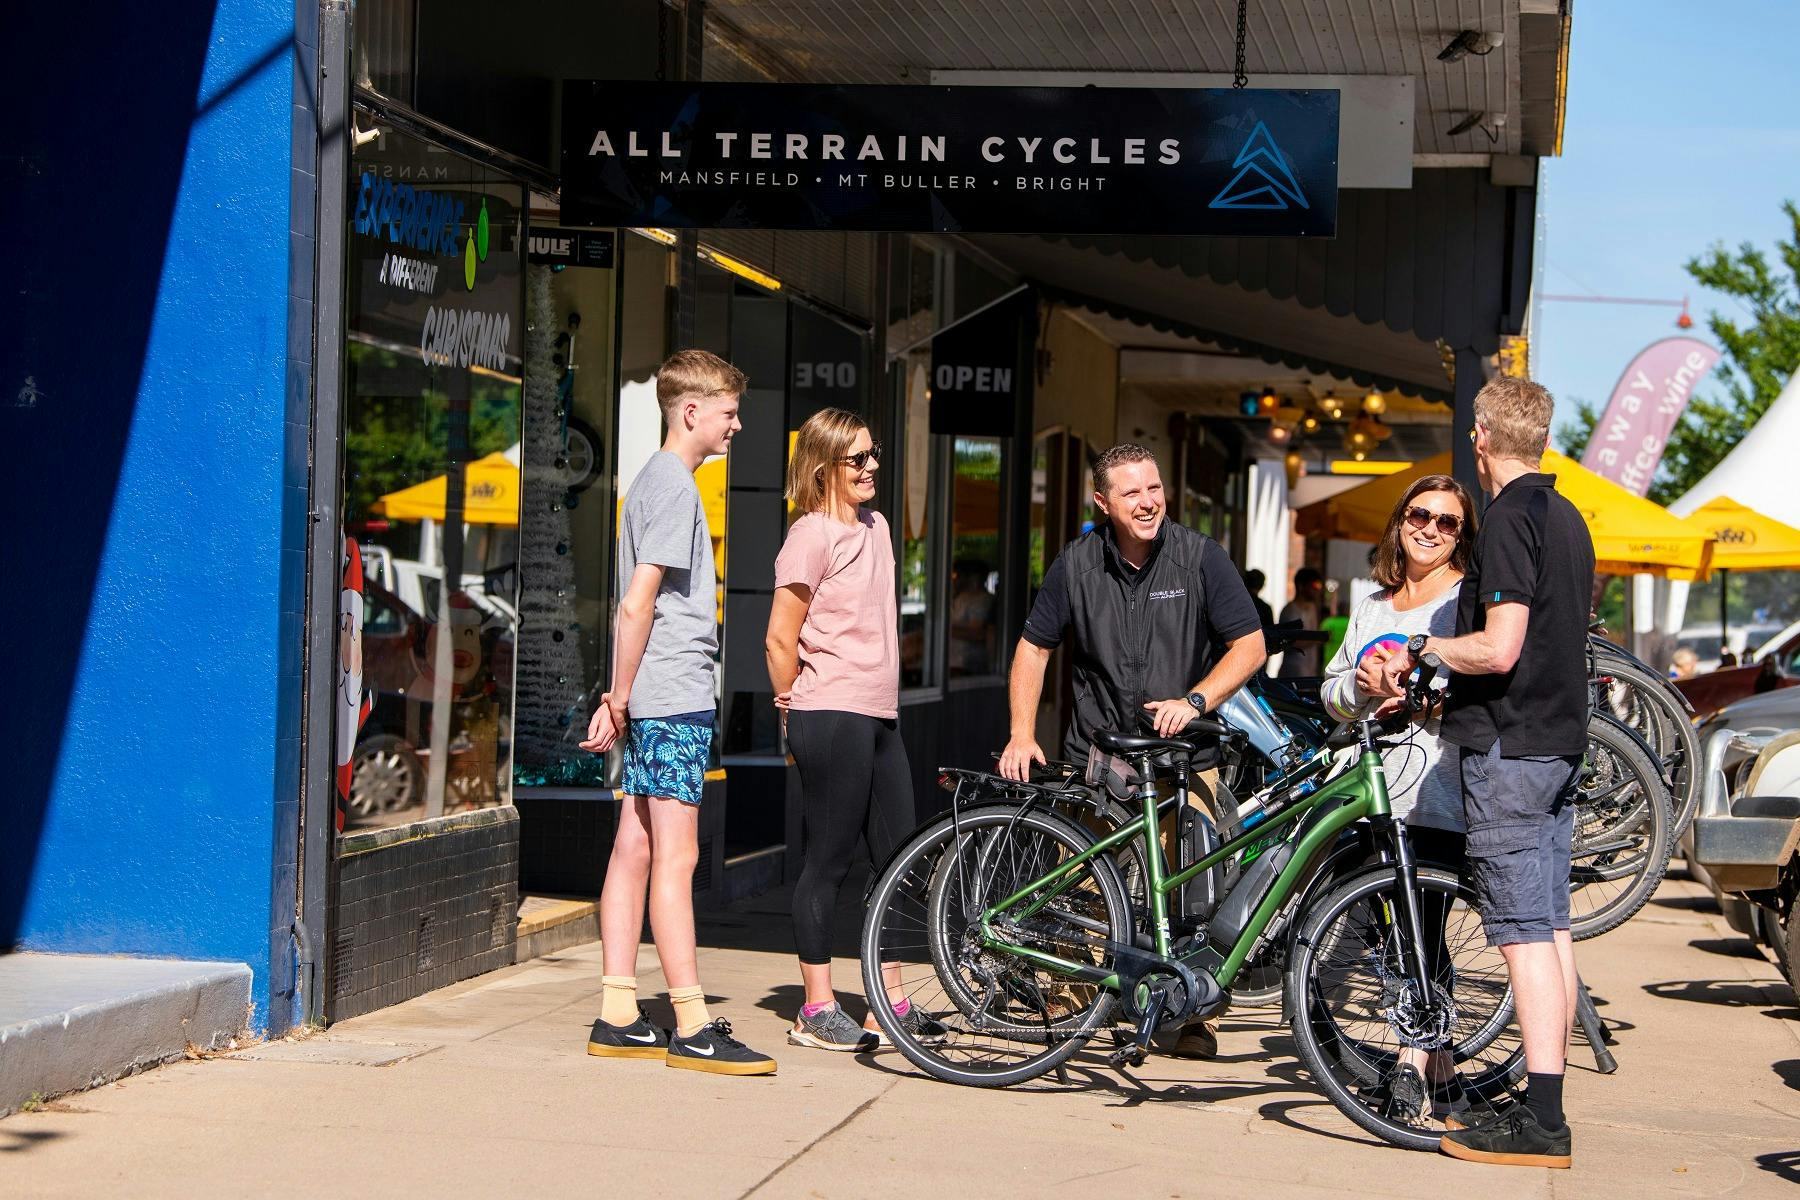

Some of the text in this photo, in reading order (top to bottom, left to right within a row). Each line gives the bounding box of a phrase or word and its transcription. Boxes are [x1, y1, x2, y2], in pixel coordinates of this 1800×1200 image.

[588, 130, 1182, 165] ALL TERRAIN CYCLES
[660, 171, 1106, 191] MANSFIELD MT BULLER BRIGHT
[355, 171, 465, 258] EXPERIENCE
[380, 252, 438, 295] A DIFFERENT
[422, 305, 510, 371] CHRISTMAS
[936, 364, 1012, 393] OPEN
[1658, 351, 1707, 415] wine
[1597, 371, 1654, 477] away
